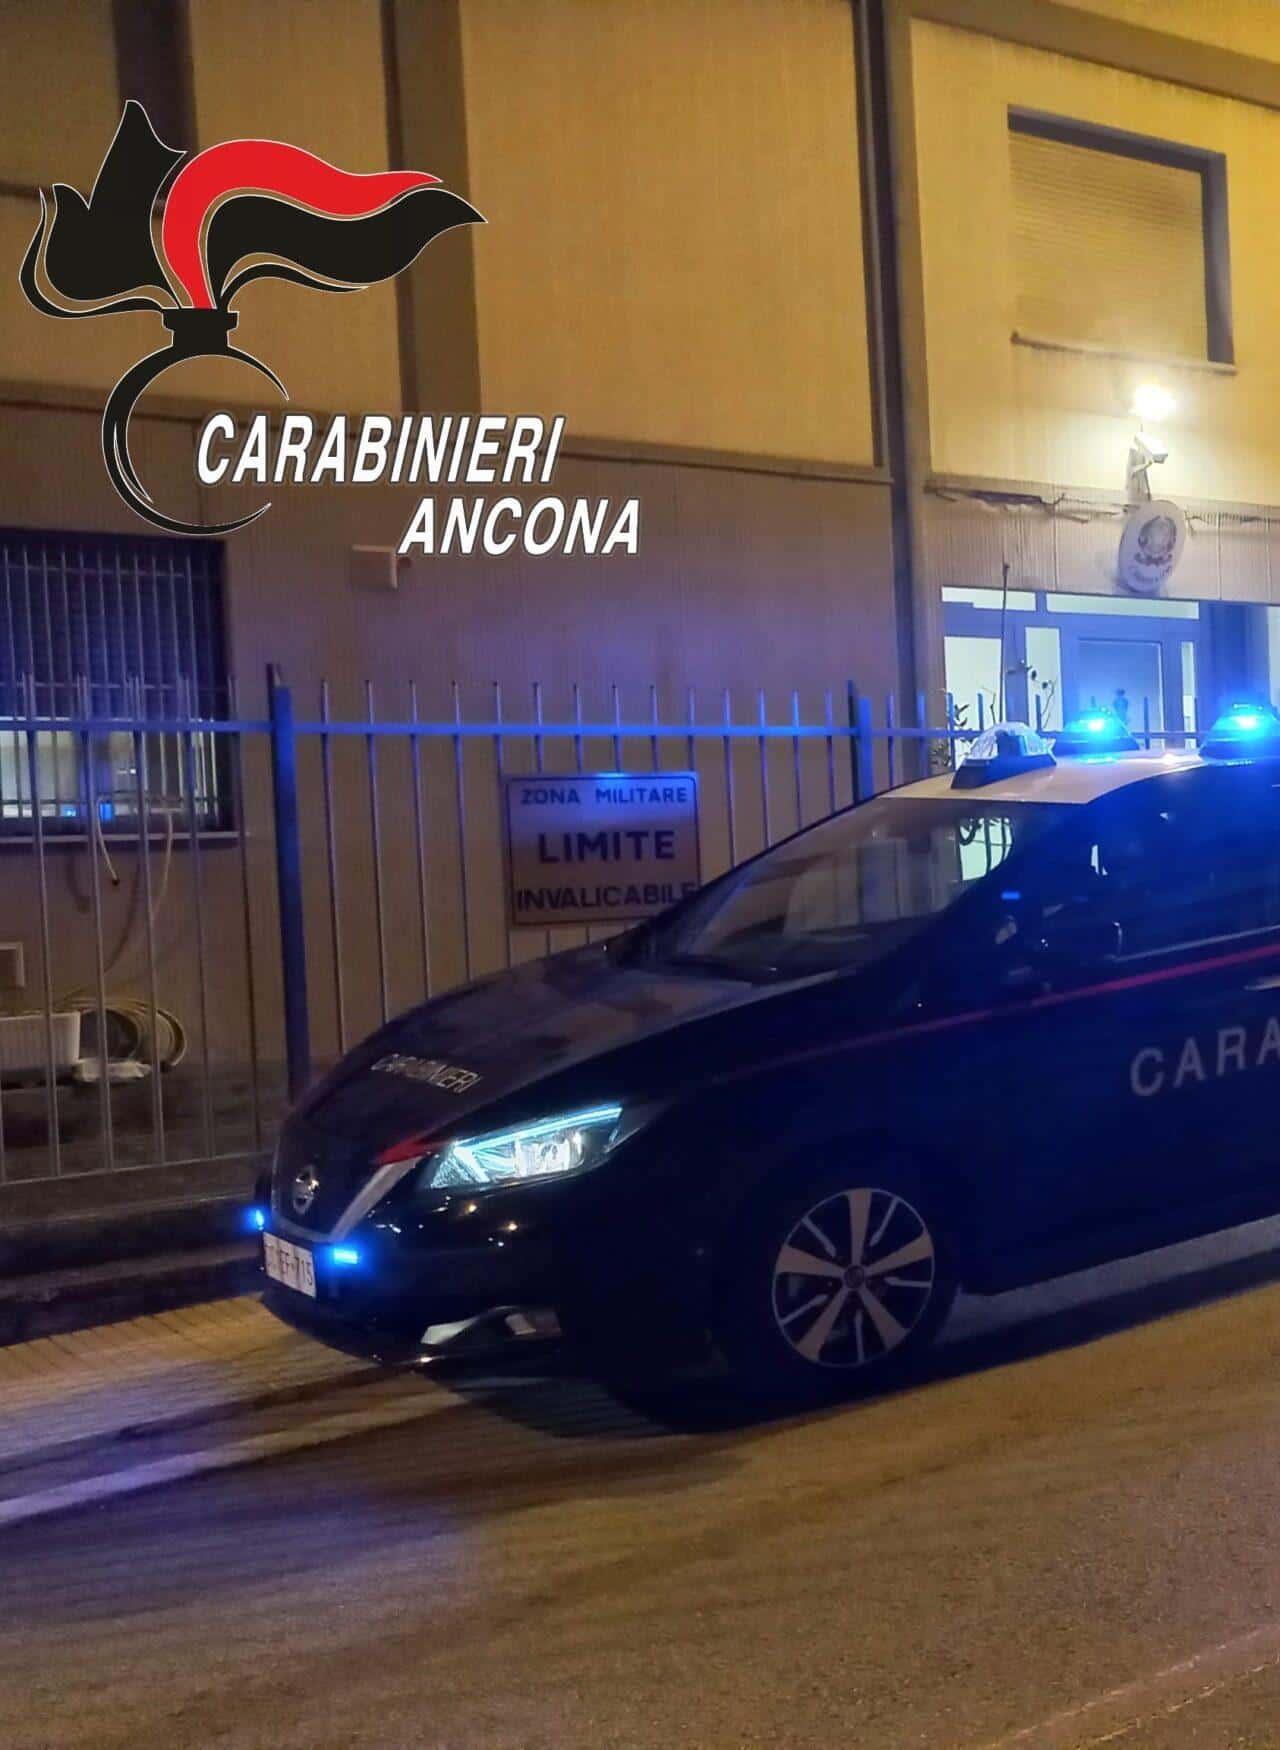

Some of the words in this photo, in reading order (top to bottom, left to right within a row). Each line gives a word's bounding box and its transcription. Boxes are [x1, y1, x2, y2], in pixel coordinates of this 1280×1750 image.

[520, 788, 581, 805] ZONA
[595, 787, 688, 804] MILITARE
[538, 830, 675, 864] LIMITE
[371, 1053, 482, 1094] CANIERI
